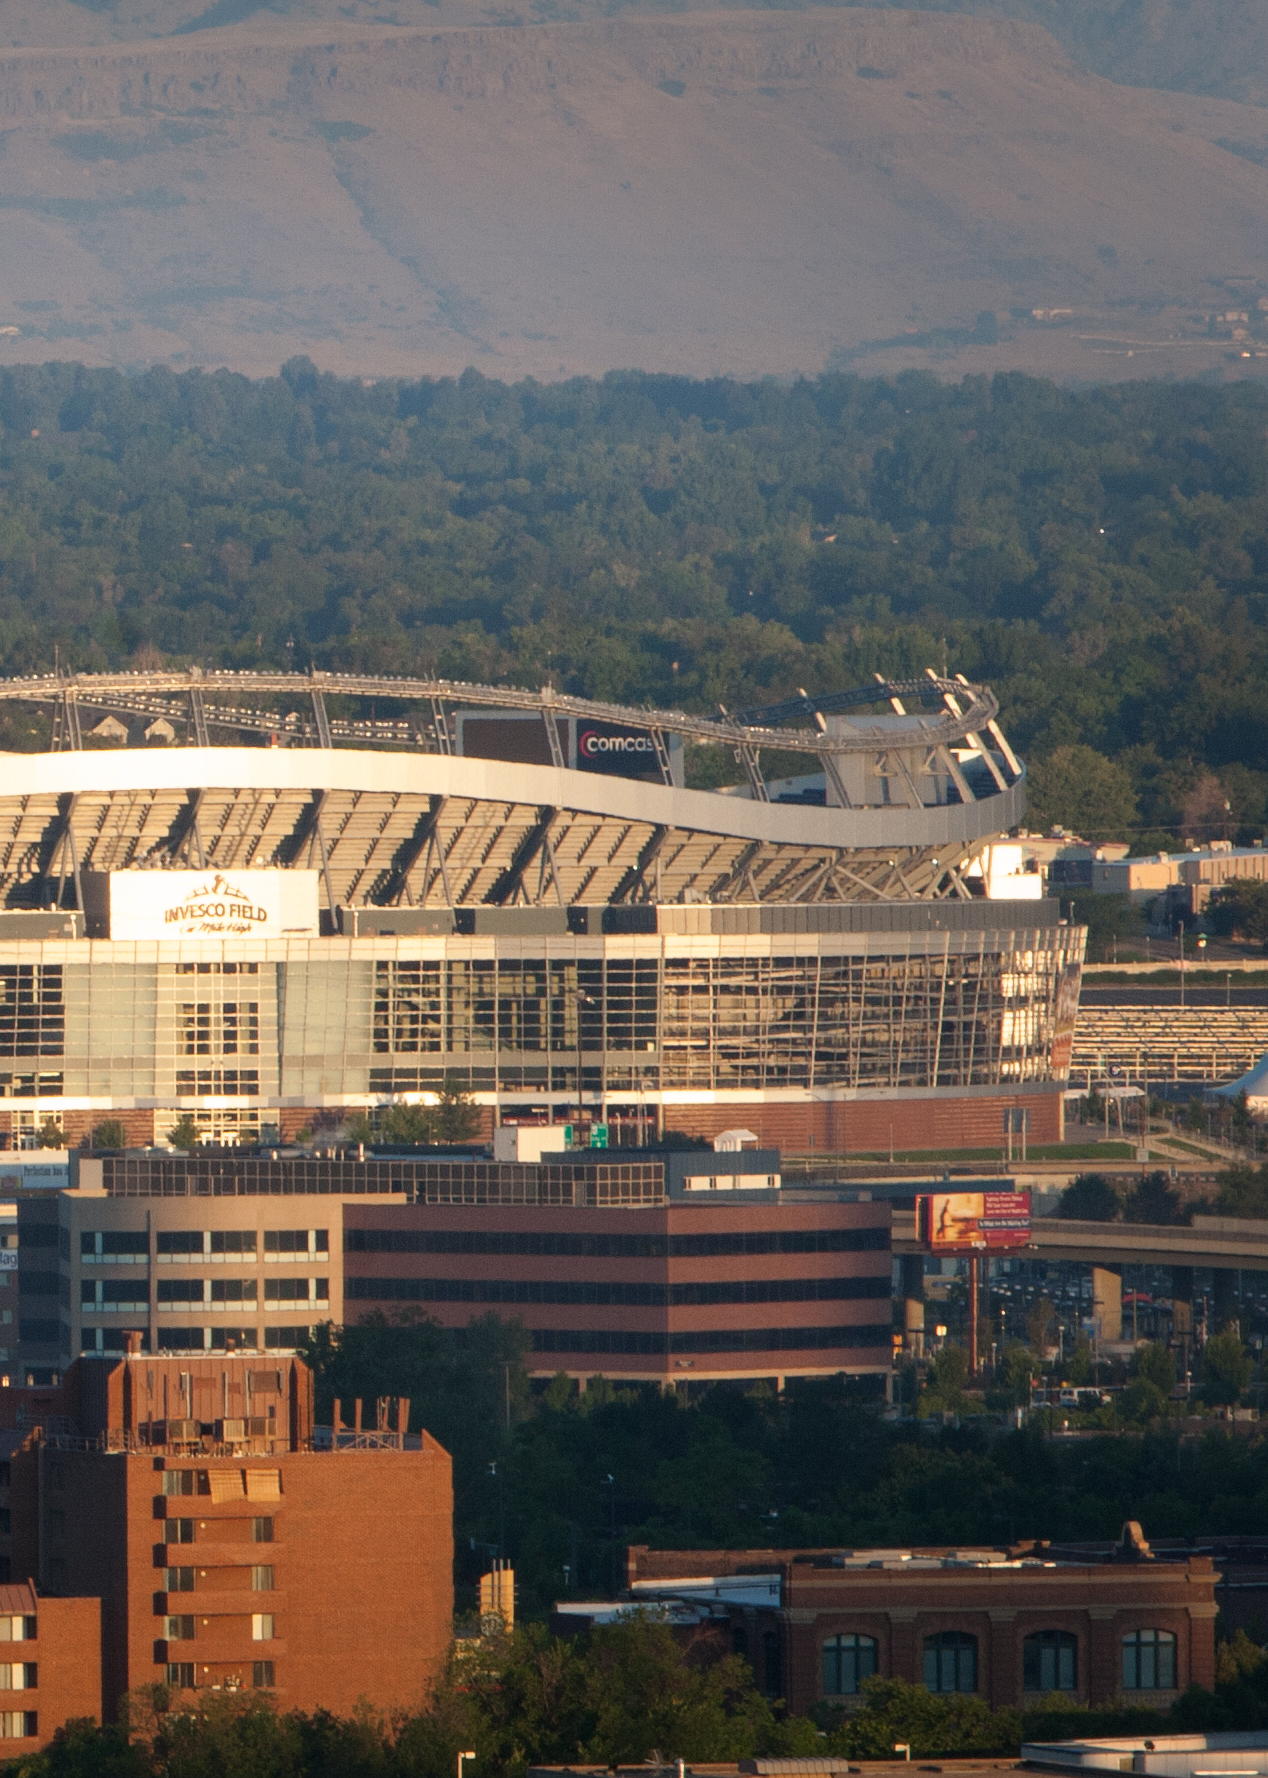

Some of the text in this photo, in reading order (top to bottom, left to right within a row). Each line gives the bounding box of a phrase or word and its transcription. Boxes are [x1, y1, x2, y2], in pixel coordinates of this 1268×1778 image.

[586, 736, 655, 752] comcas
[164, 903, 268, 924] INVESCO FIELD
[226, 922, 253, 935] High
